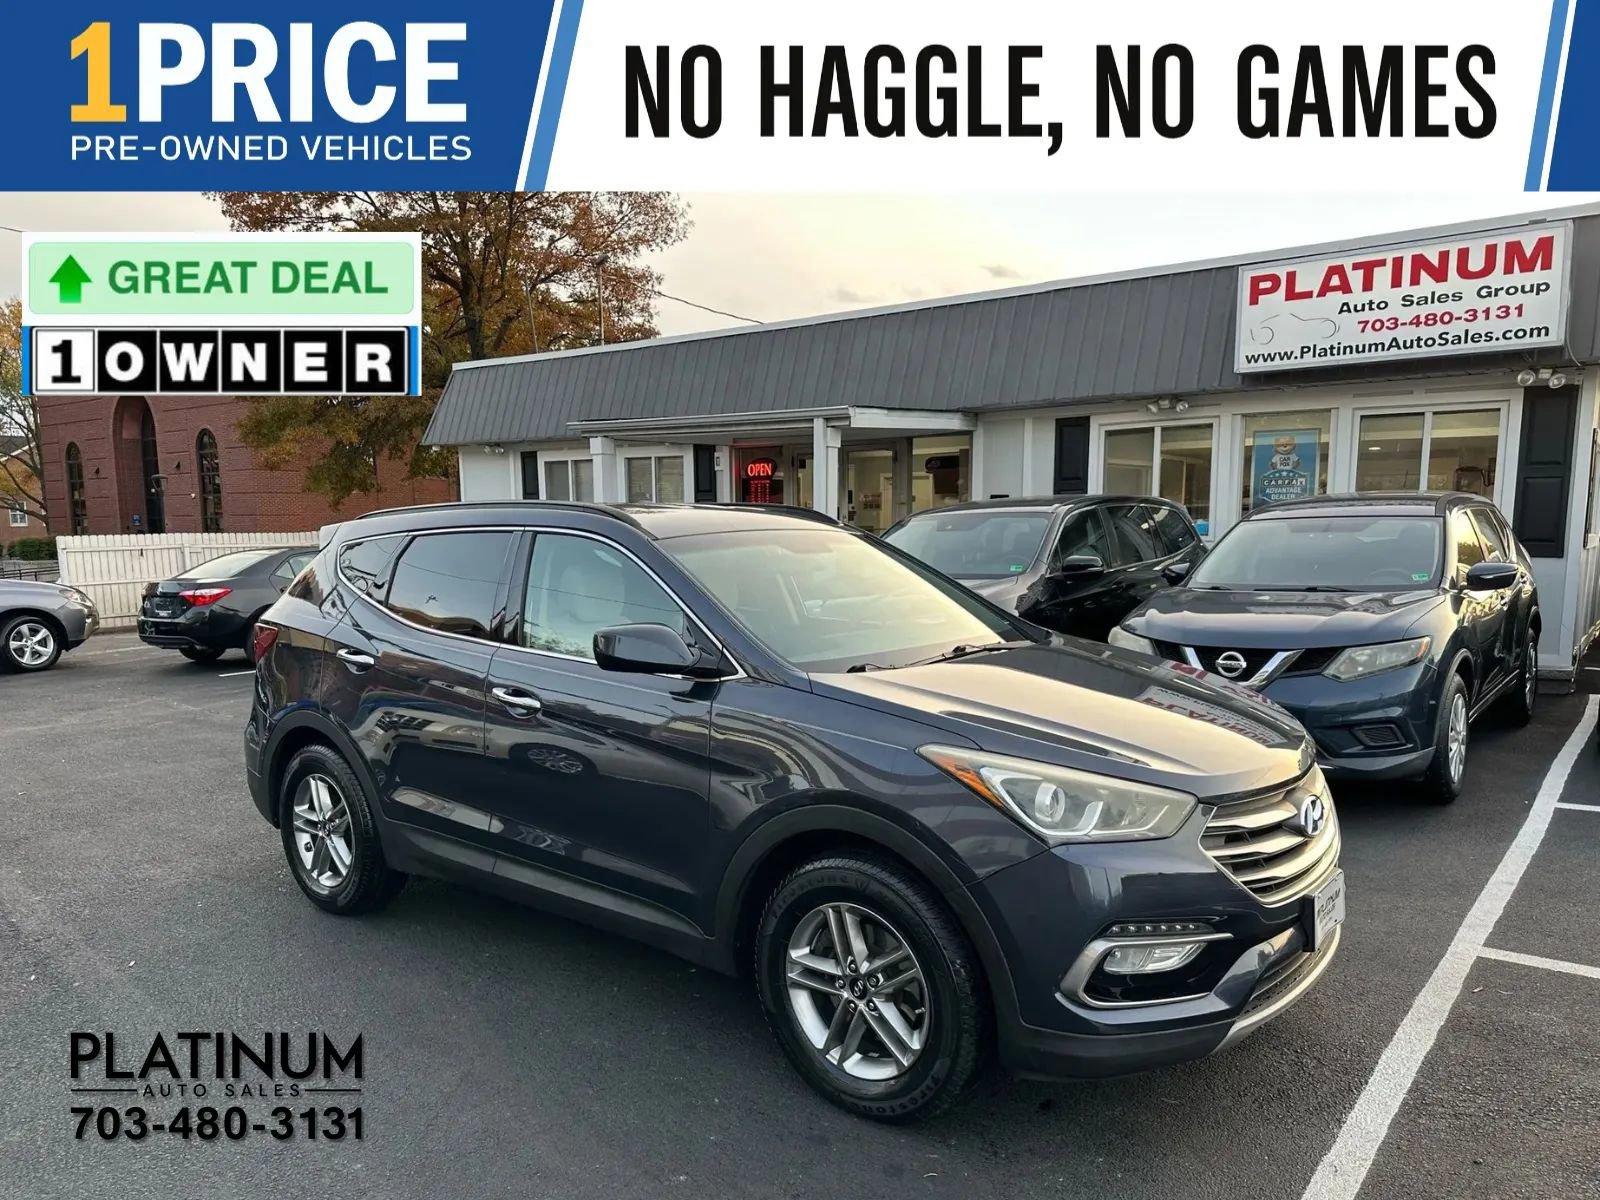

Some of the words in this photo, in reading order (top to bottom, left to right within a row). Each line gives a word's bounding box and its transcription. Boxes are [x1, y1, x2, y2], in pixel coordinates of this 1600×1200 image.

[1249, 236, 1554, 306] PLATINUM
[1338, 298, 1389, 315] Auto
[1401, 289, 1463, 308] Sales
[1476, 280, 1551, 299] Group
[1358, 303, 1524, 334] 703-480-3131
[1245, 324, 1549, 364] www.PlatinumAutoSales.com
[747, 463, 772, 477] OPEN
